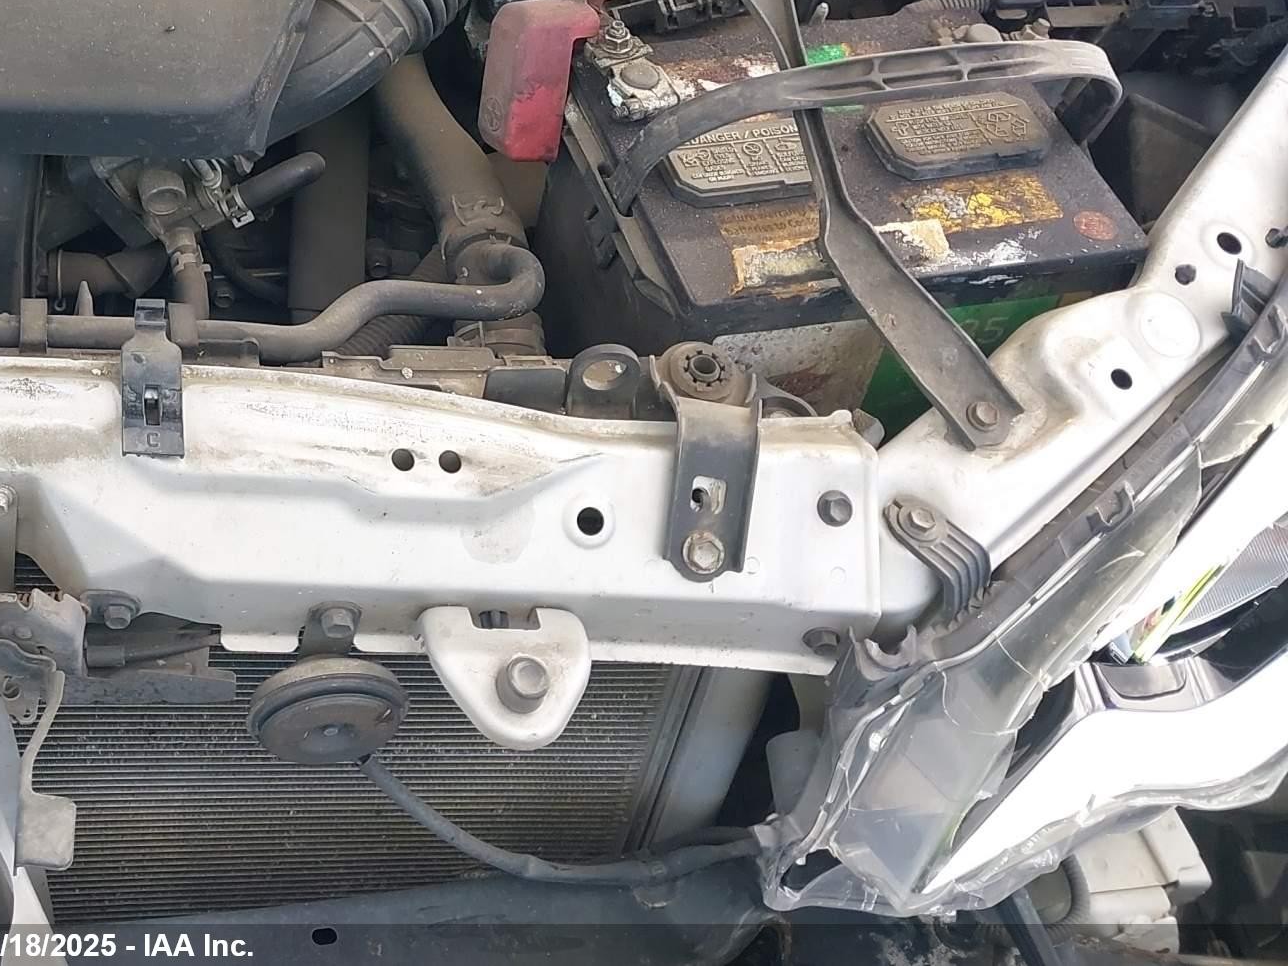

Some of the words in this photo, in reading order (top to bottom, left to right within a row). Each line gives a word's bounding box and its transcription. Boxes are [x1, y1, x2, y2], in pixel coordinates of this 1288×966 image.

[693, 131, 740, 145] DANGER
[753, 124, 799, 139] POISON
[146, 431, 160, 448] C
